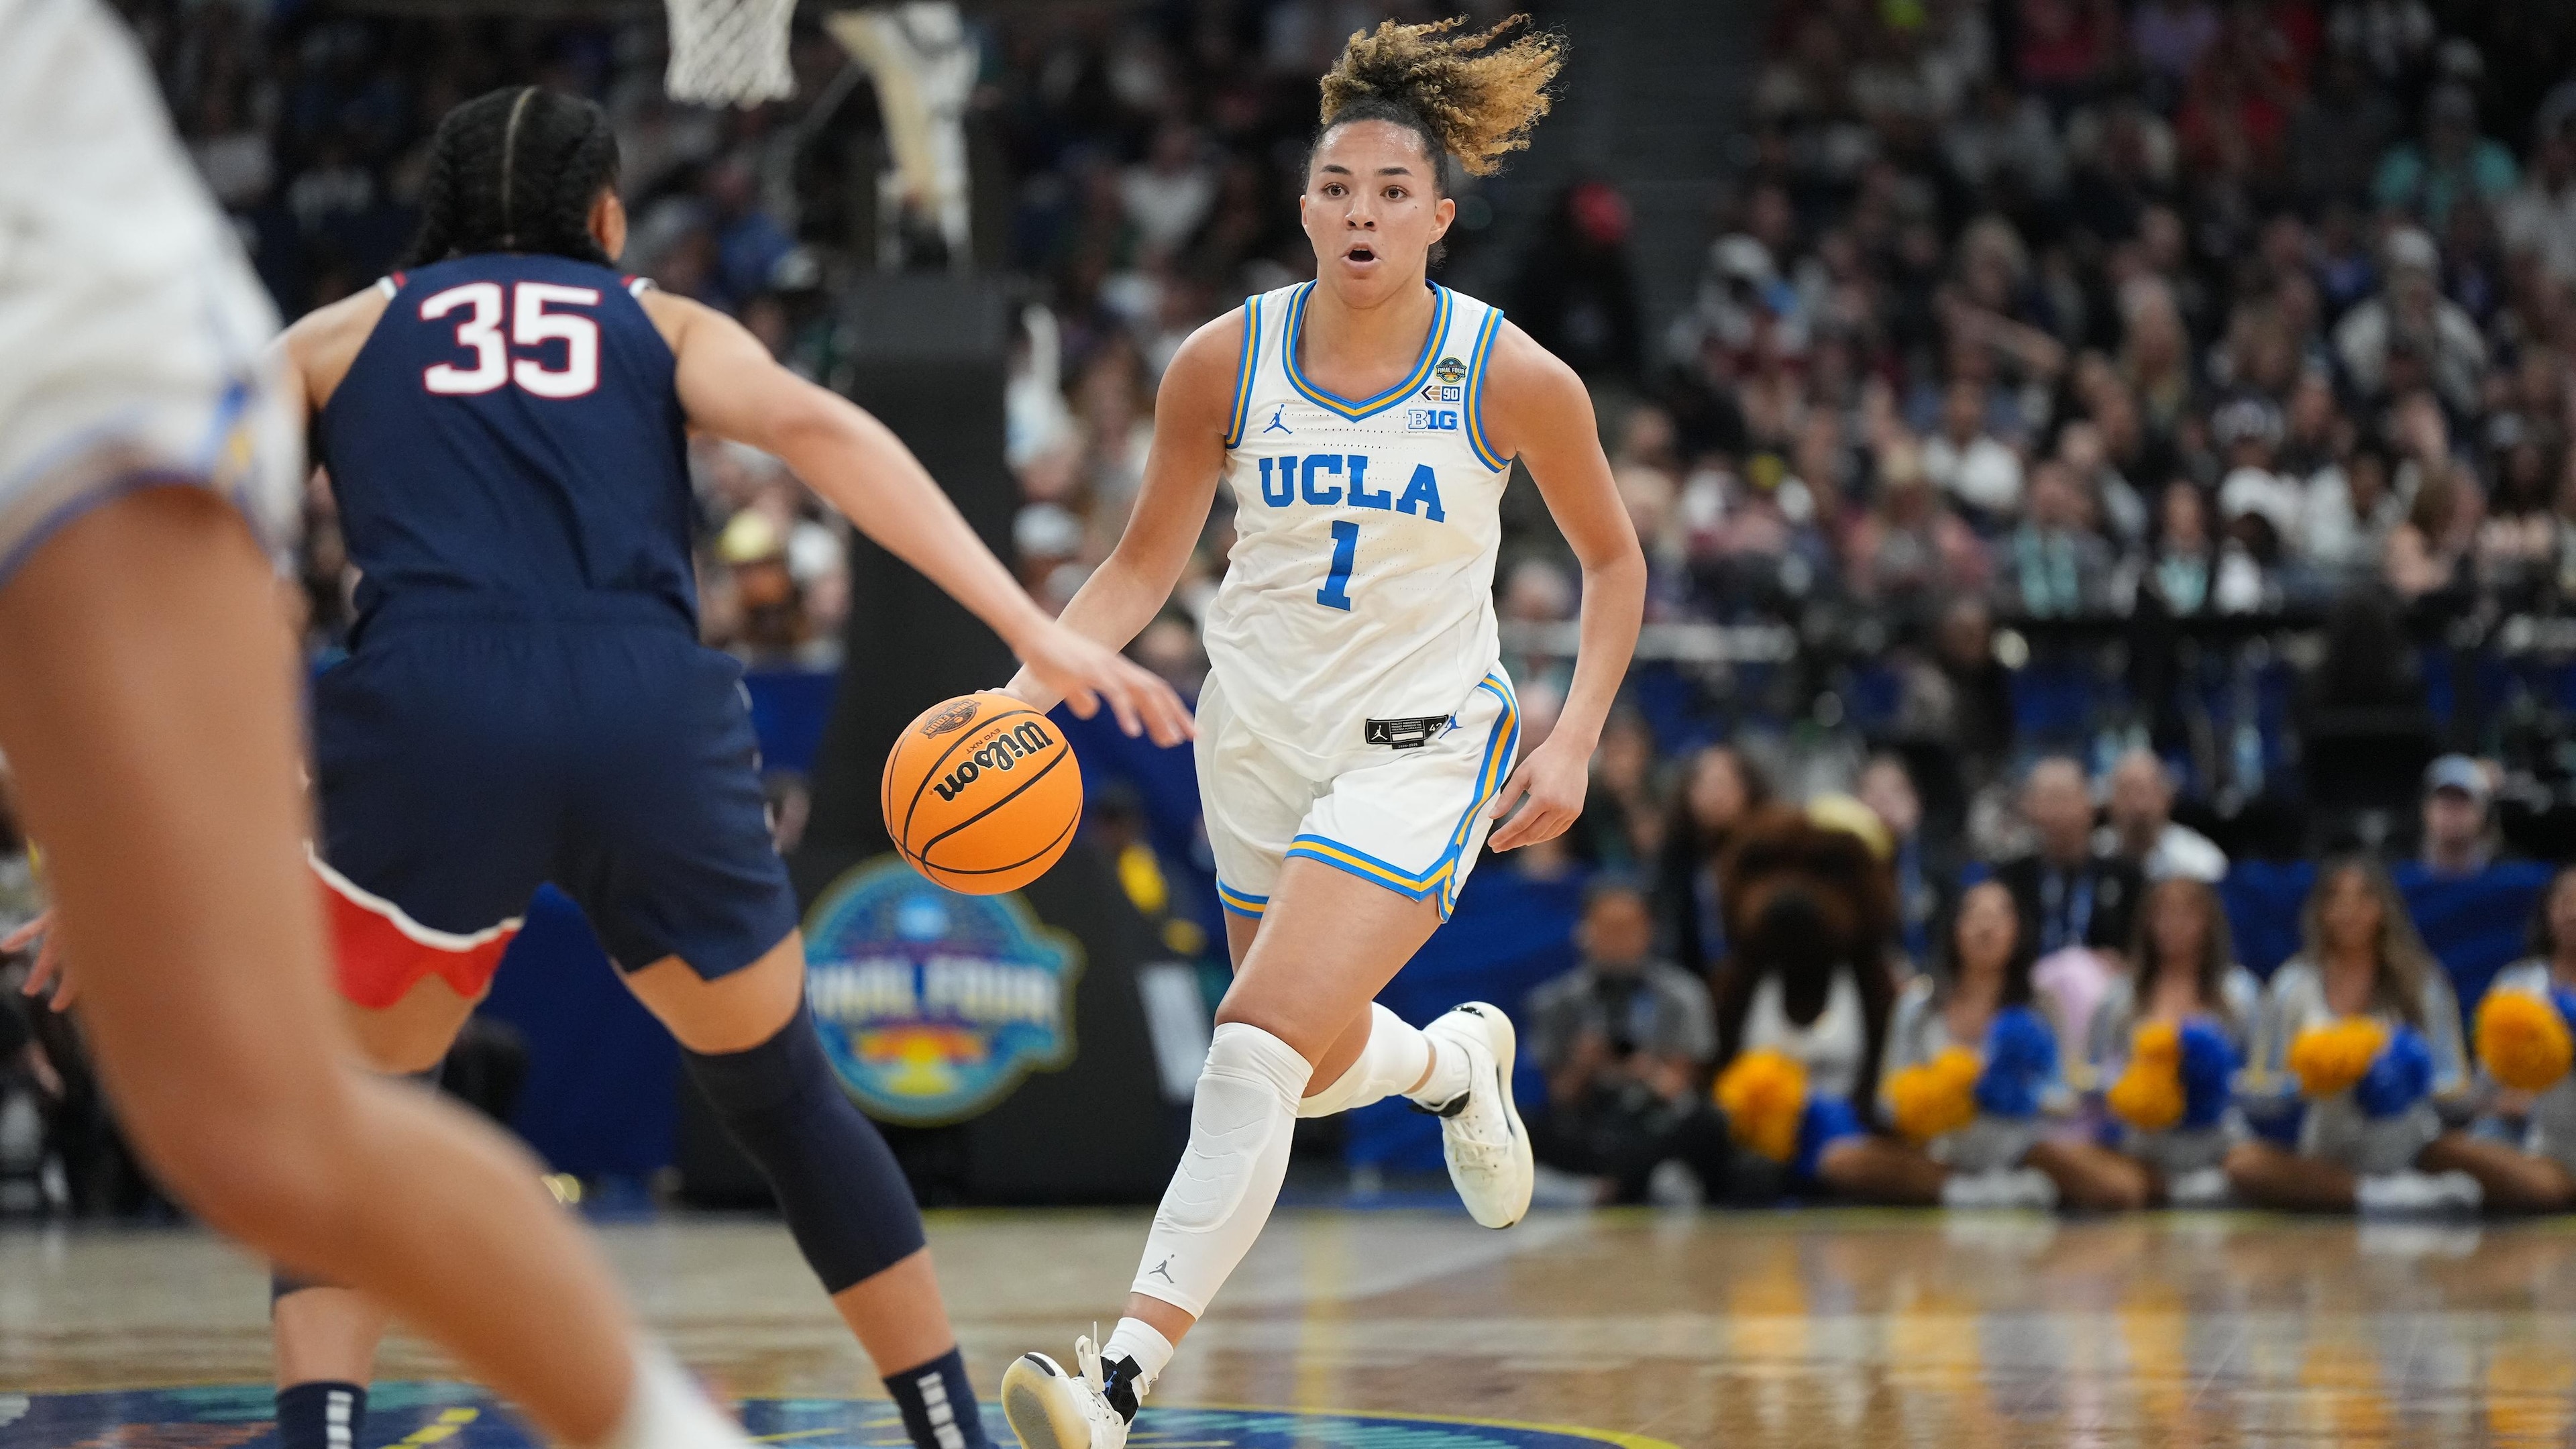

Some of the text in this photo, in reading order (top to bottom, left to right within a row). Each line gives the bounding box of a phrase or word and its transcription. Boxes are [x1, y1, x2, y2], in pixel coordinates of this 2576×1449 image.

[419, 281, 601, 400] 35
[1443, 388, 1458, 400] 90
[1258, 453, 1446, 523] UCLA
[1316, 519, 1360, 612] 1
[925, 714, 951, 735] FOUR
[966, 728, 1002, 755] EVO NXT
[933, 720, 1055, 802] Wilson
